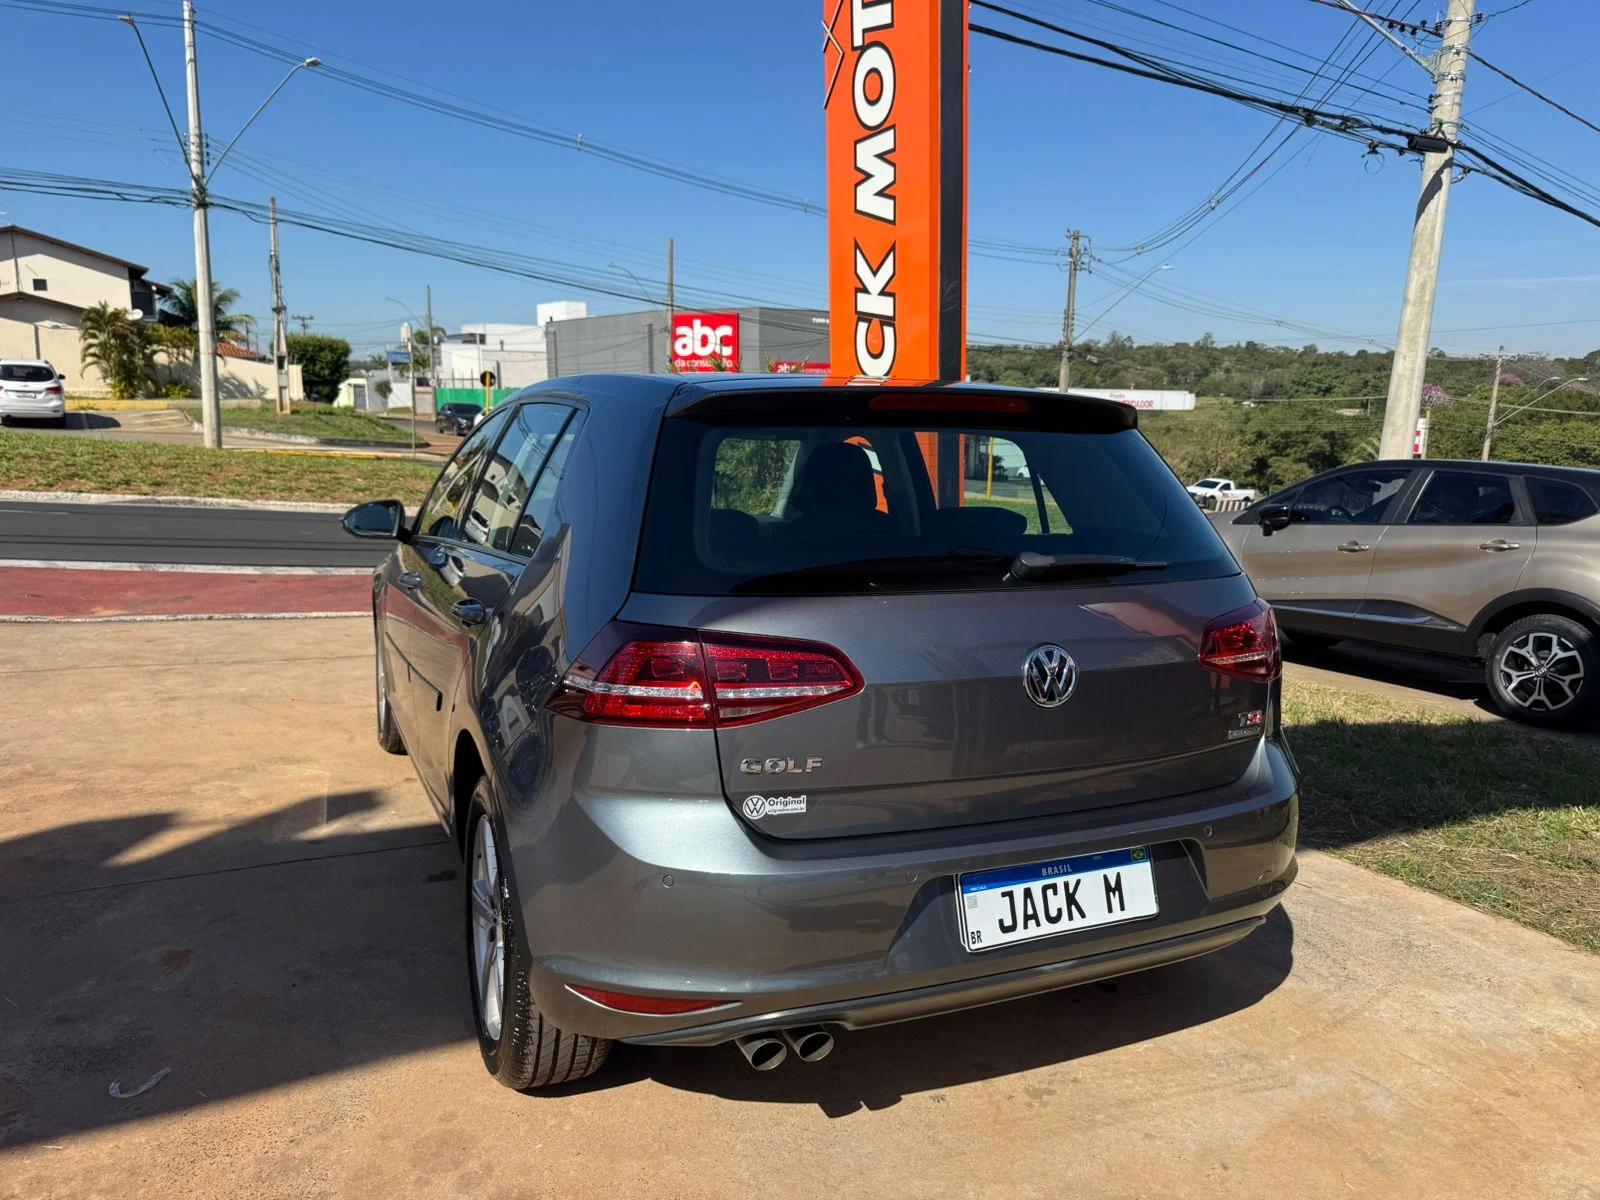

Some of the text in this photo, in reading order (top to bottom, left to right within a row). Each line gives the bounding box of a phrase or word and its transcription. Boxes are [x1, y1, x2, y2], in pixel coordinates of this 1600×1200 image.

[674, 318, 733, 357] abc
[739, 756, 824, 775] GOLF
[768, 796, 805, 808] Original
[1041, 863, 1073, 877] BRASIL
[998, 871, 1126, 934] JACK M
[970, 930, 983, 945] BR
